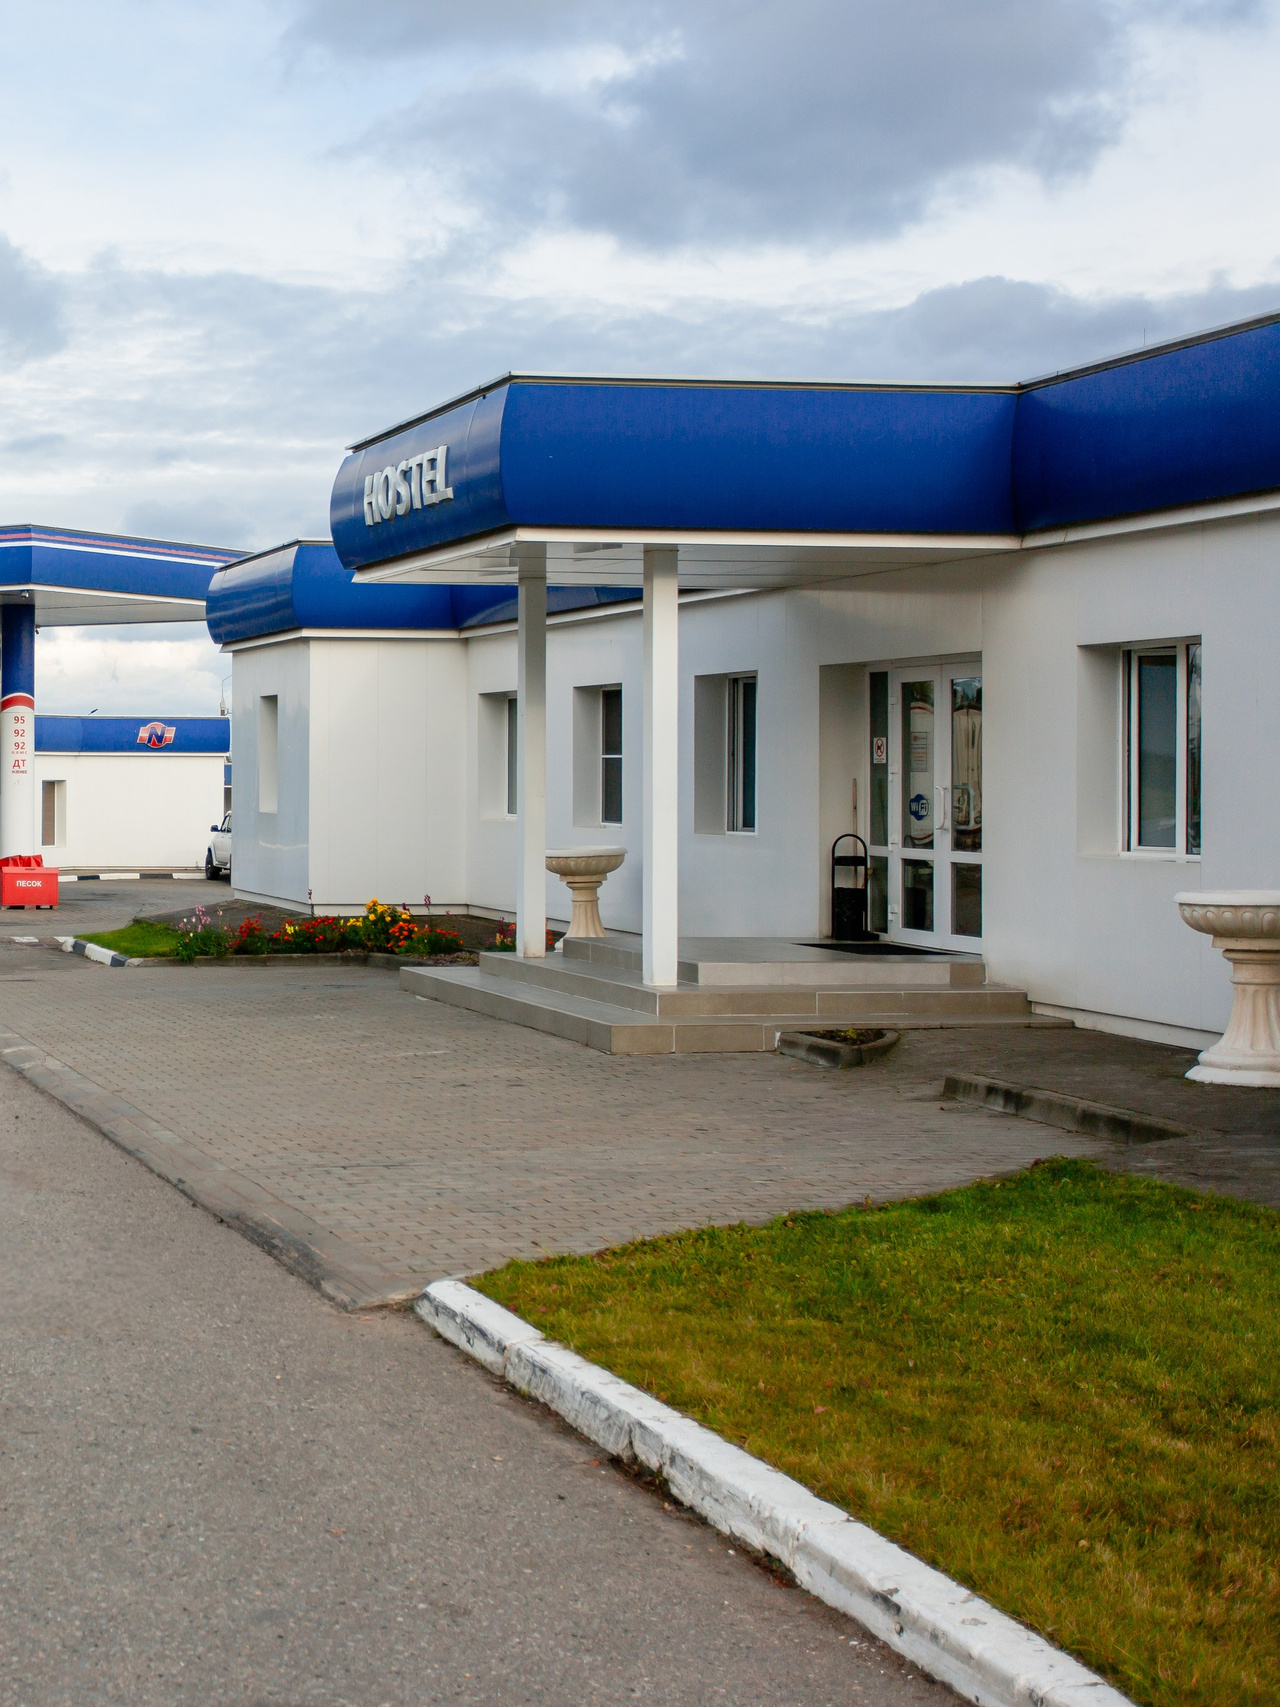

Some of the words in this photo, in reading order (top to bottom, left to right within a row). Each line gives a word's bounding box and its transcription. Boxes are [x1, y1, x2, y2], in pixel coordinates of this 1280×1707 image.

[363, 443, 454, 526] HOSTEL
[13, 715, 26, 725] 95
[13, 728, 26, 738] 92
[13, 741, 26, 750] 92
[12, 759, 27, 769] ДТ
[15, 879, 42, 888] ПЕСОК
